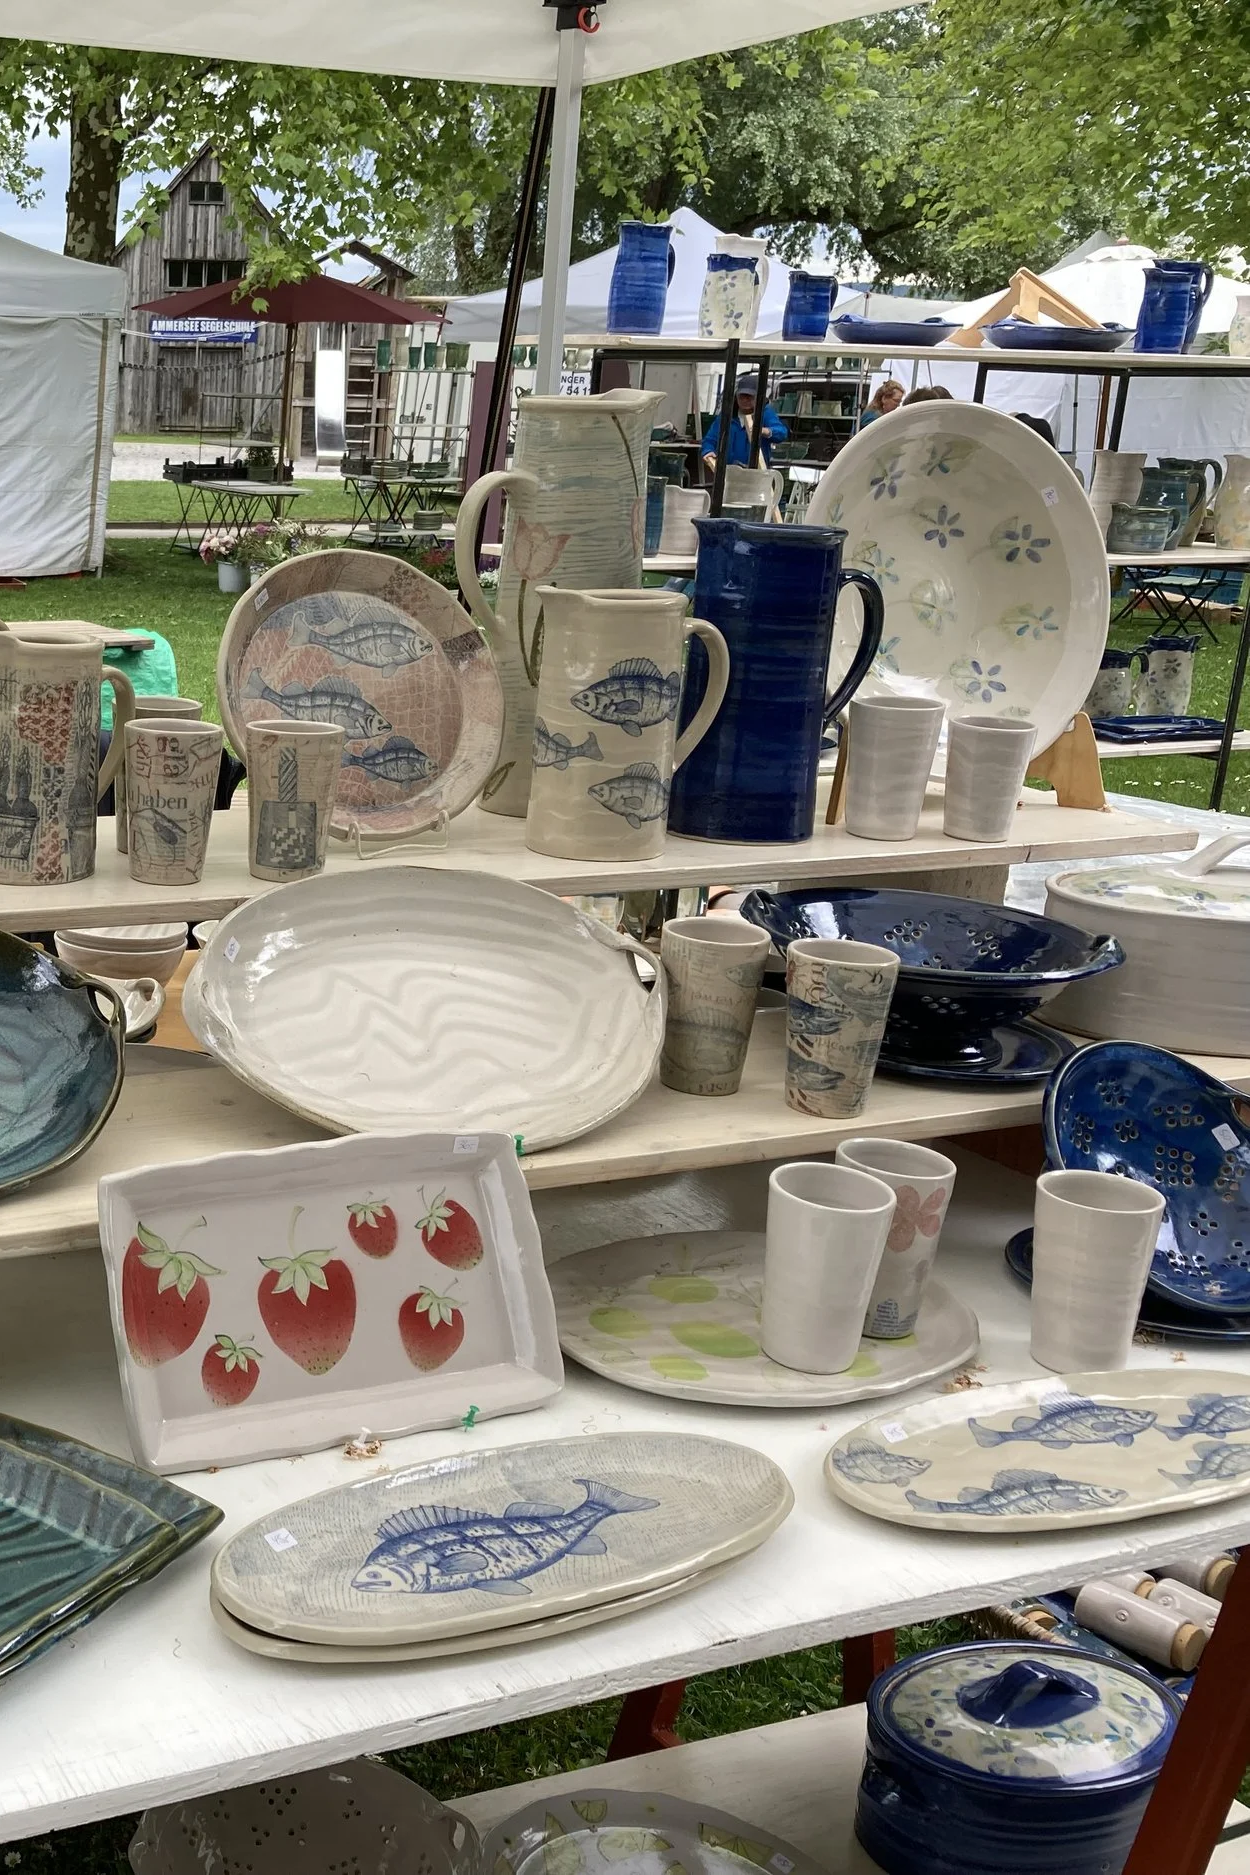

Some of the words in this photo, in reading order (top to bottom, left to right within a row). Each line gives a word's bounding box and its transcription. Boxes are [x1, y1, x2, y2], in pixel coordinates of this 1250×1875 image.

[152, 320, 199, 331] AMMERSEE
[200, 321, 256, 333] SEGELSCHULE
[137, 785, 188, 810] haben
